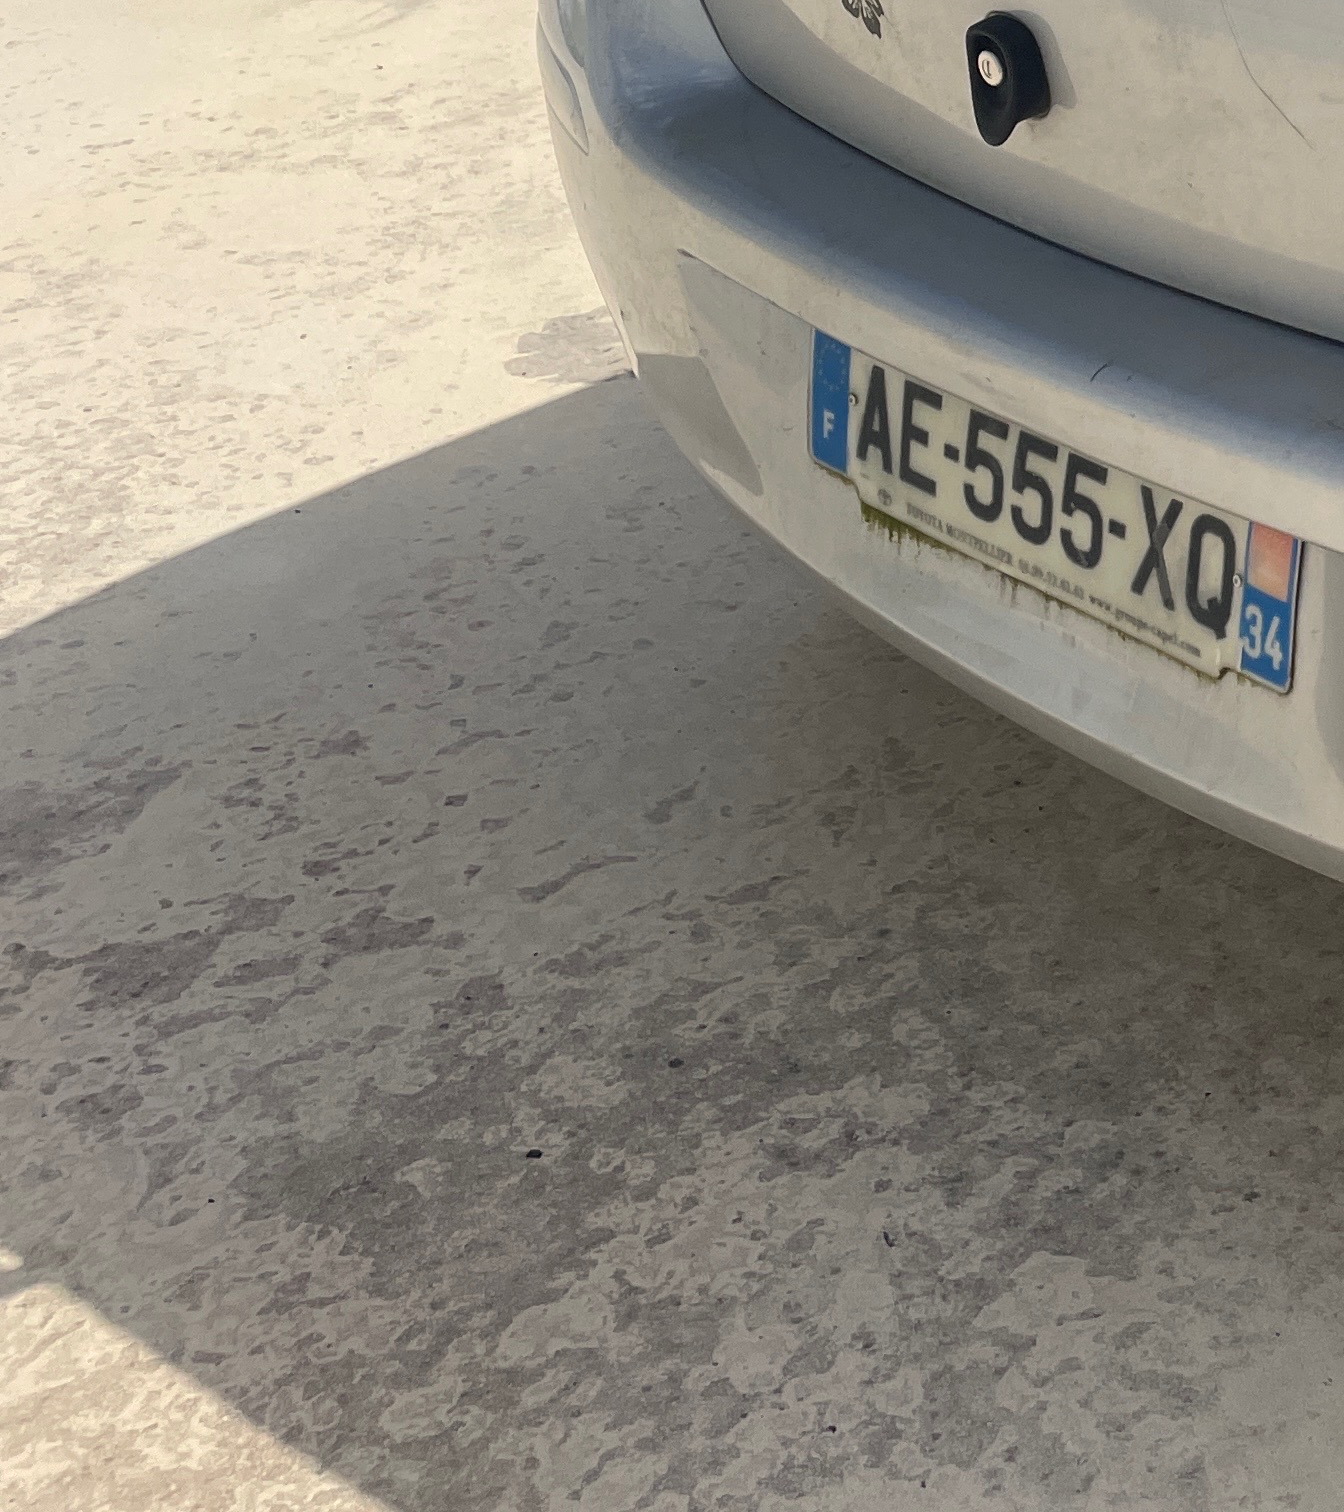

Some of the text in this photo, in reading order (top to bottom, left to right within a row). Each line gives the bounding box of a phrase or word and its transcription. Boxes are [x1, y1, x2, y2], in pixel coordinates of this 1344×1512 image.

[822, 411, 834, 439] F
[855, 364, 1237, 641] AE-555-XQ
[1245, 603, 1284, 671] 34
